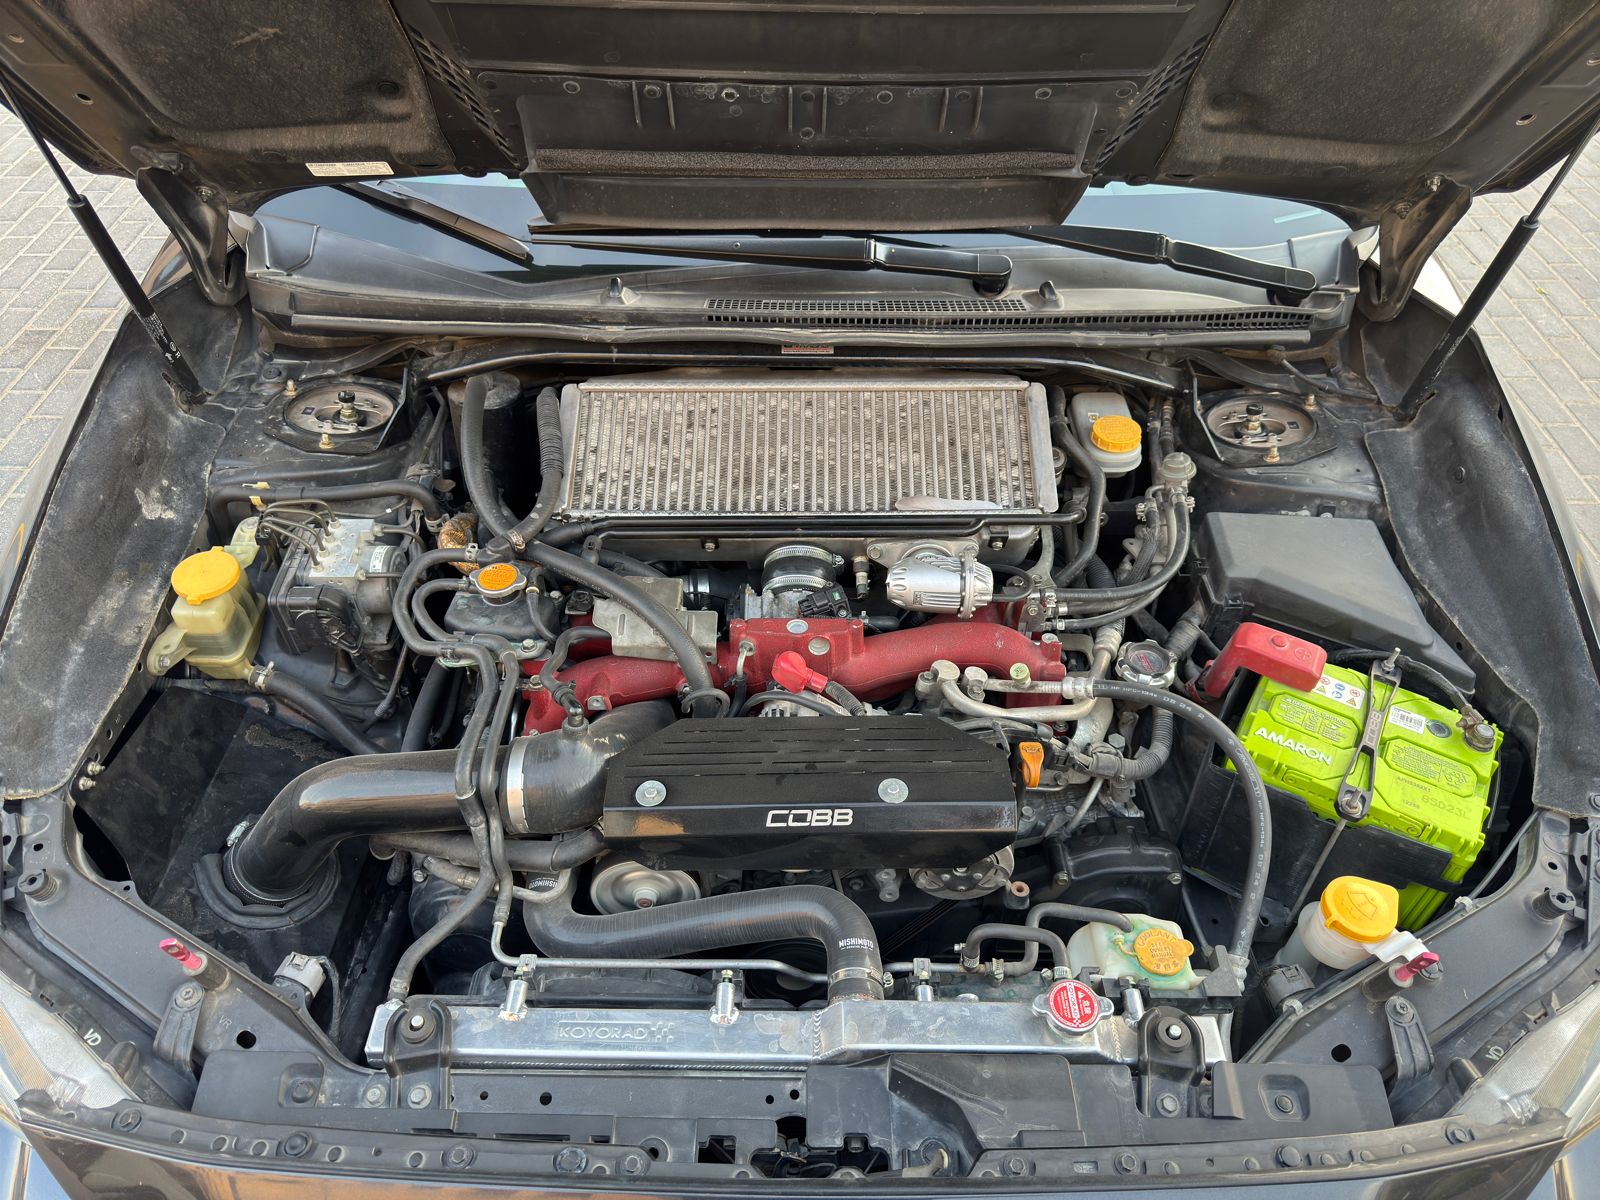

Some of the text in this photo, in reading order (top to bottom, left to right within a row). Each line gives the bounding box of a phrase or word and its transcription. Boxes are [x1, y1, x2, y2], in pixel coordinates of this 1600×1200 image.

[1254, 727, 1332, 764] AMARON
[765, 808, 854, 827] COBB
[838, 937, 874, 949] MISHIMOTO
[1068, 983, 1079, 1017] KOYORAD
[83, 1028, 102, 1047] VD
[559, 1026, 649, 1040] KOYORAD
[1485, 1046, 1505, 1061] VD
